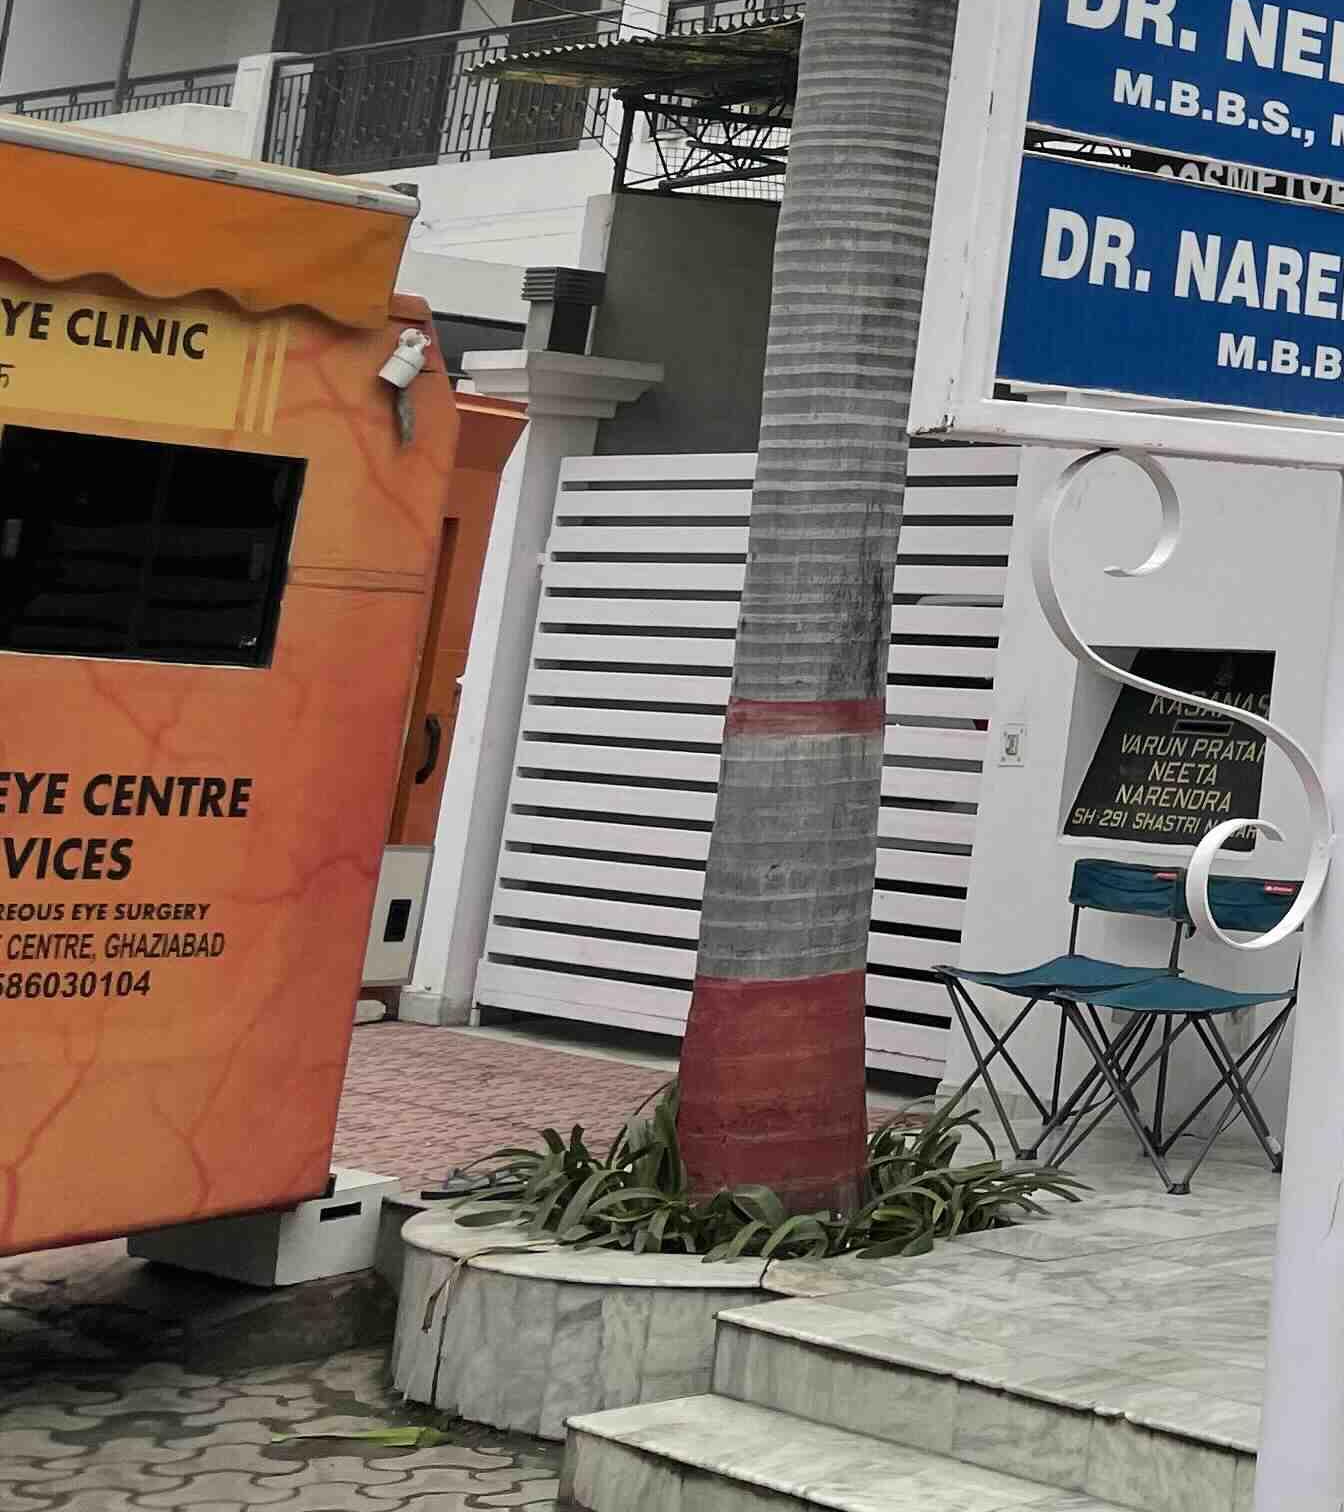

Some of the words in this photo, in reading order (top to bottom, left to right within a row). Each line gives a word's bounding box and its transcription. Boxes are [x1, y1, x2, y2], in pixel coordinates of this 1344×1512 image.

[1112, 67, 1316, 149] M.B.B.S.,
[1039, 206, 1152, 293] DR.
[66, 307, 210, 361] CLINIC
[1120, 732, 1189, 758] VARUN
[1146, 759, 1219, 787] NEETA
[82, 773, 254, 819] CENTRE
[1114, 782, 1233, 814] NARENDRA
[1131, 811, 1202, 835] SHASTRI
[71, 902, 110, 921] EYE
[112, 902, 212, 922] SURGERY
[104, 931, 227, 960] GHAZIABAD
